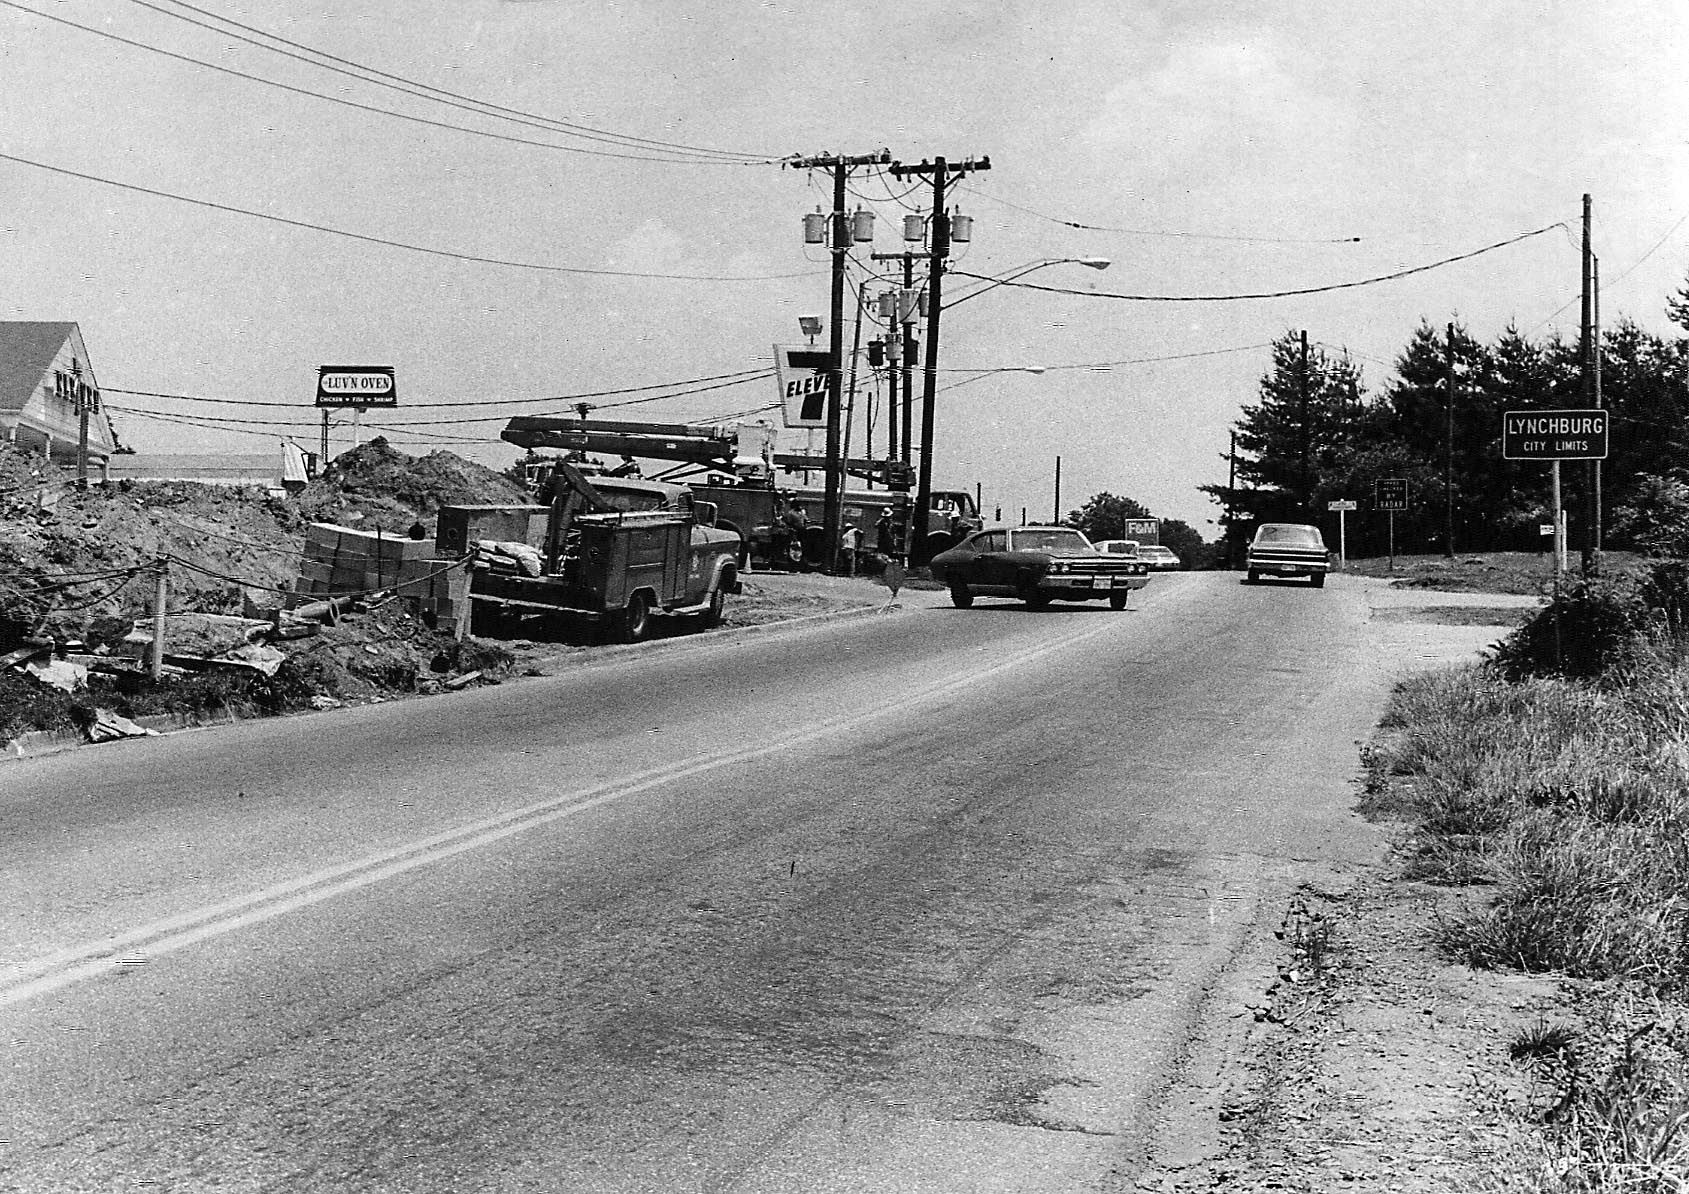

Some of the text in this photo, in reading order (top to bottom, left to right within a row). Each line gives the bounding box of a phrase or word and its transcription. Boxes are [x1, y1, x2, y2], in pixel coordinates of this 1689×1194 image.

[328, 376, 358, 389] LUV'N
[361, 377, 390, 389] OVEN
[786, 374, 831, 397] ELEVE
[1509, 418, 1603, 434] LYNCHBURG
[1523, 441, 1588, 451] CITY LIMITS
[1380, 500, 1403, 508] RADAR
[1129, 522, 1156, 534] F&M
